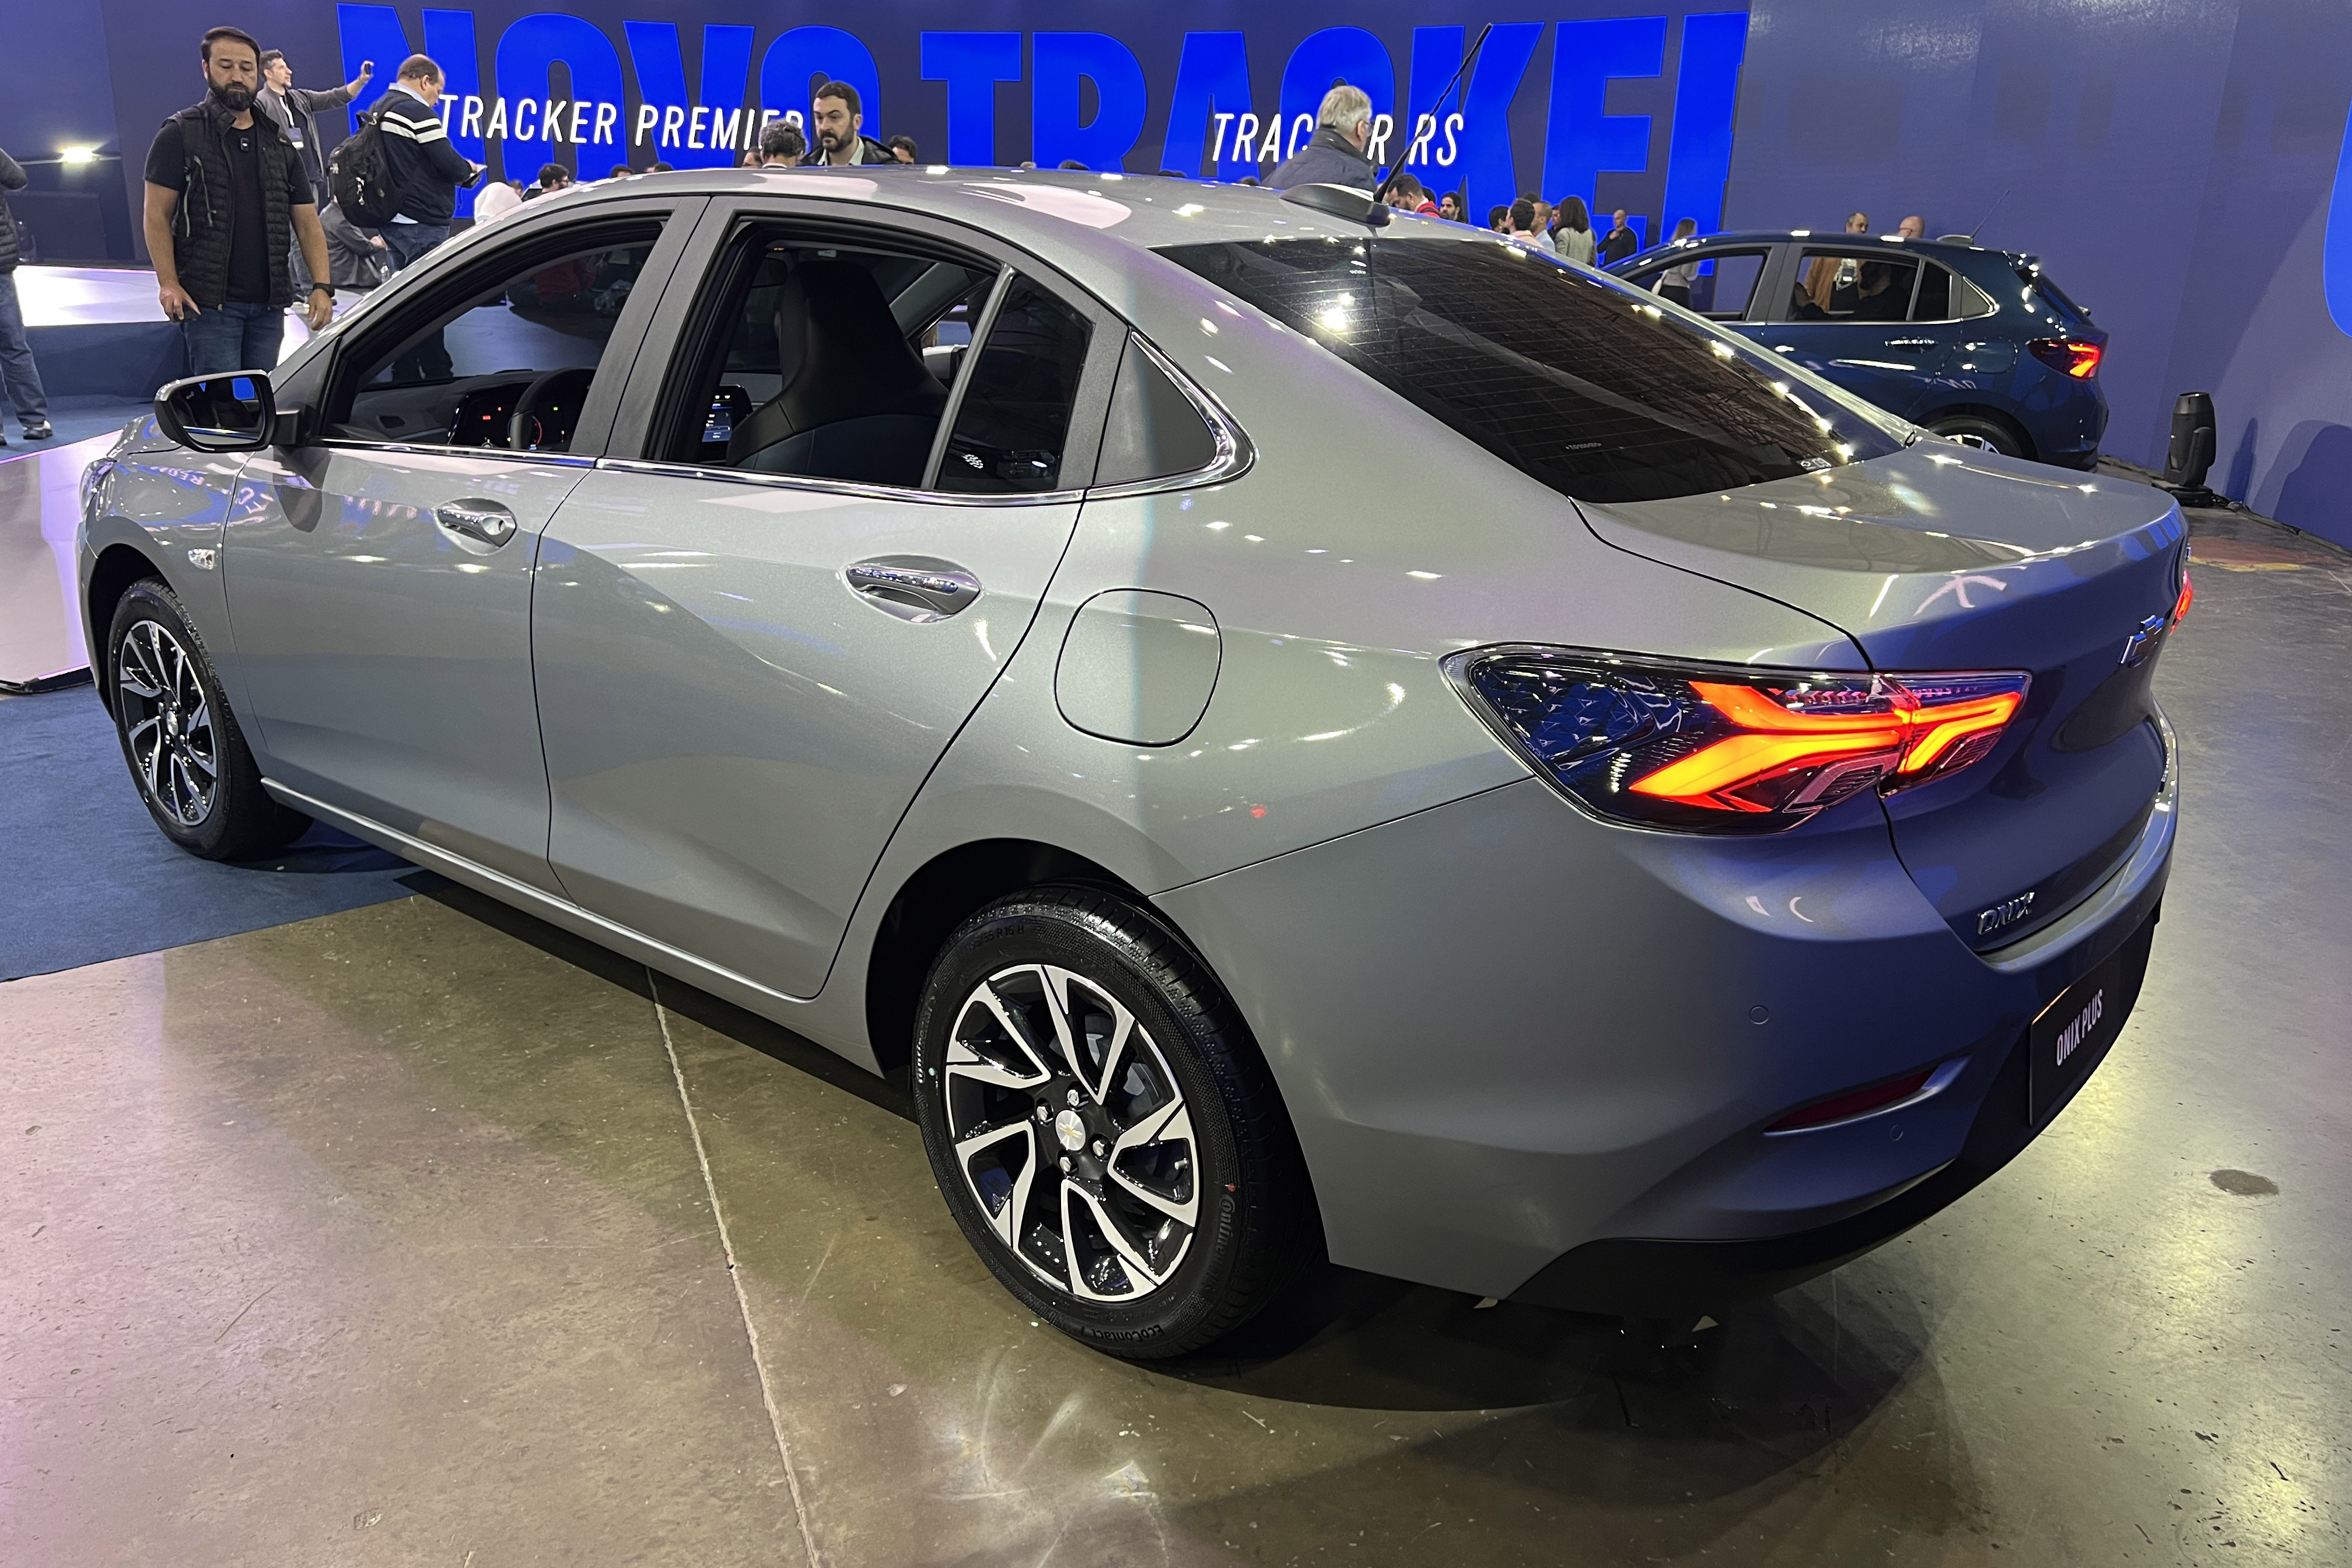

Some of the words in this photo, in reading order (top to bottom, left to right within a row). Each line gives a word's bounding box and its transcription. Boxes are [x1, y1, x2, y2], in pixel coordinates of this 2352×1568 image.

[336, 2, 881, 219] NOVO
[438, 93, 618, 145] TRACKER
[1212, 113, 1394, 165] TRACR
[1408, 113, 1464, 166] RS
[1978, 892, 2035, 935] ONIX
[2056, 1014, 2081, 1066] ONIX
[2081, 988, 2103, 1039] PLUS
[1091, 1324, 1166, 1342] EcoContact
